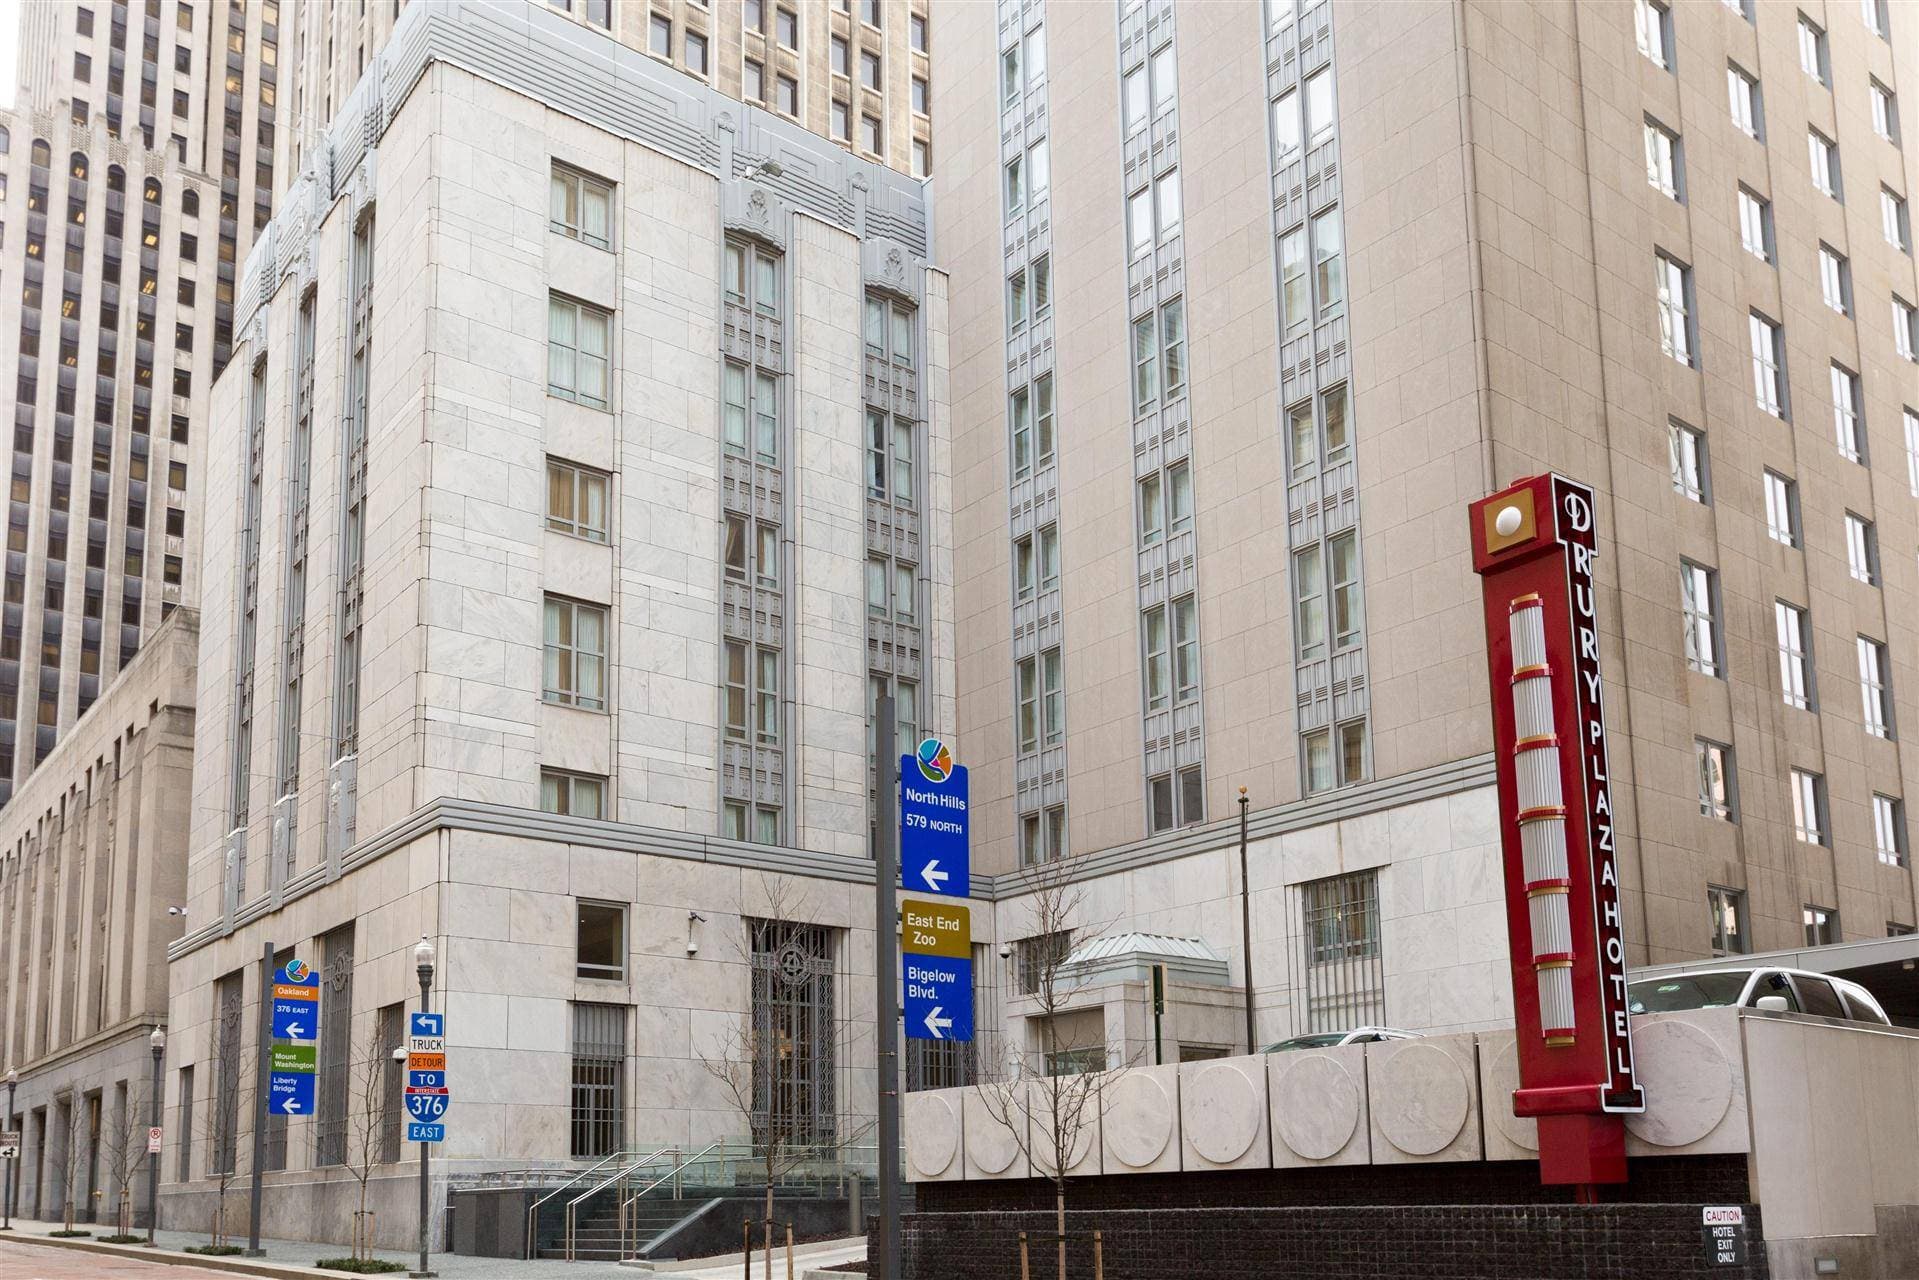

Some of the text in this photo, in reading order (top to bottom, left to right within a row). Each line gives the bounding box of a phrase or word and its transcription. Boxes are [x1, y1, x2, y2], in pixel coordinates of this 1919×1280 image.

[1564, 491, 1631, 1074] DRURY PLAZA HOTEL
[906, 787, 966, 810] North Hills
[906, 813, 963, 834] 579 NORTH
[907, 912, 960, 931] East End
[913, 931, 936, 946] Zoo
[908, 966, 956, 984] Bigelow
[277, 986, 310, 997] Oakland
[908, 984, 939, 1000] Blvd.
[276, 1005, 291, 1014] 376
[412, 1039, 443, 1050] TRUCK
[274, 1060, 315, 1070] Washington
[411, 1057, 443, 1067] DETOUR
[273, 1077, 298, 1087] Liberty
[418, 1074, 436, 1085] TO
[273, 1084, 296, 1093] Bridge
[411, 1095, 443, 1115] 376
[413, 1126, 440, 1138] EAST
[1705, 1210, 1740, 1221] CAUTION
[1712, 1226, 1736, 1238] HOTEL
[1717, 1239, 1733, 1250] EXIT
[1717, 1251, 1736, 1263] ONLY
